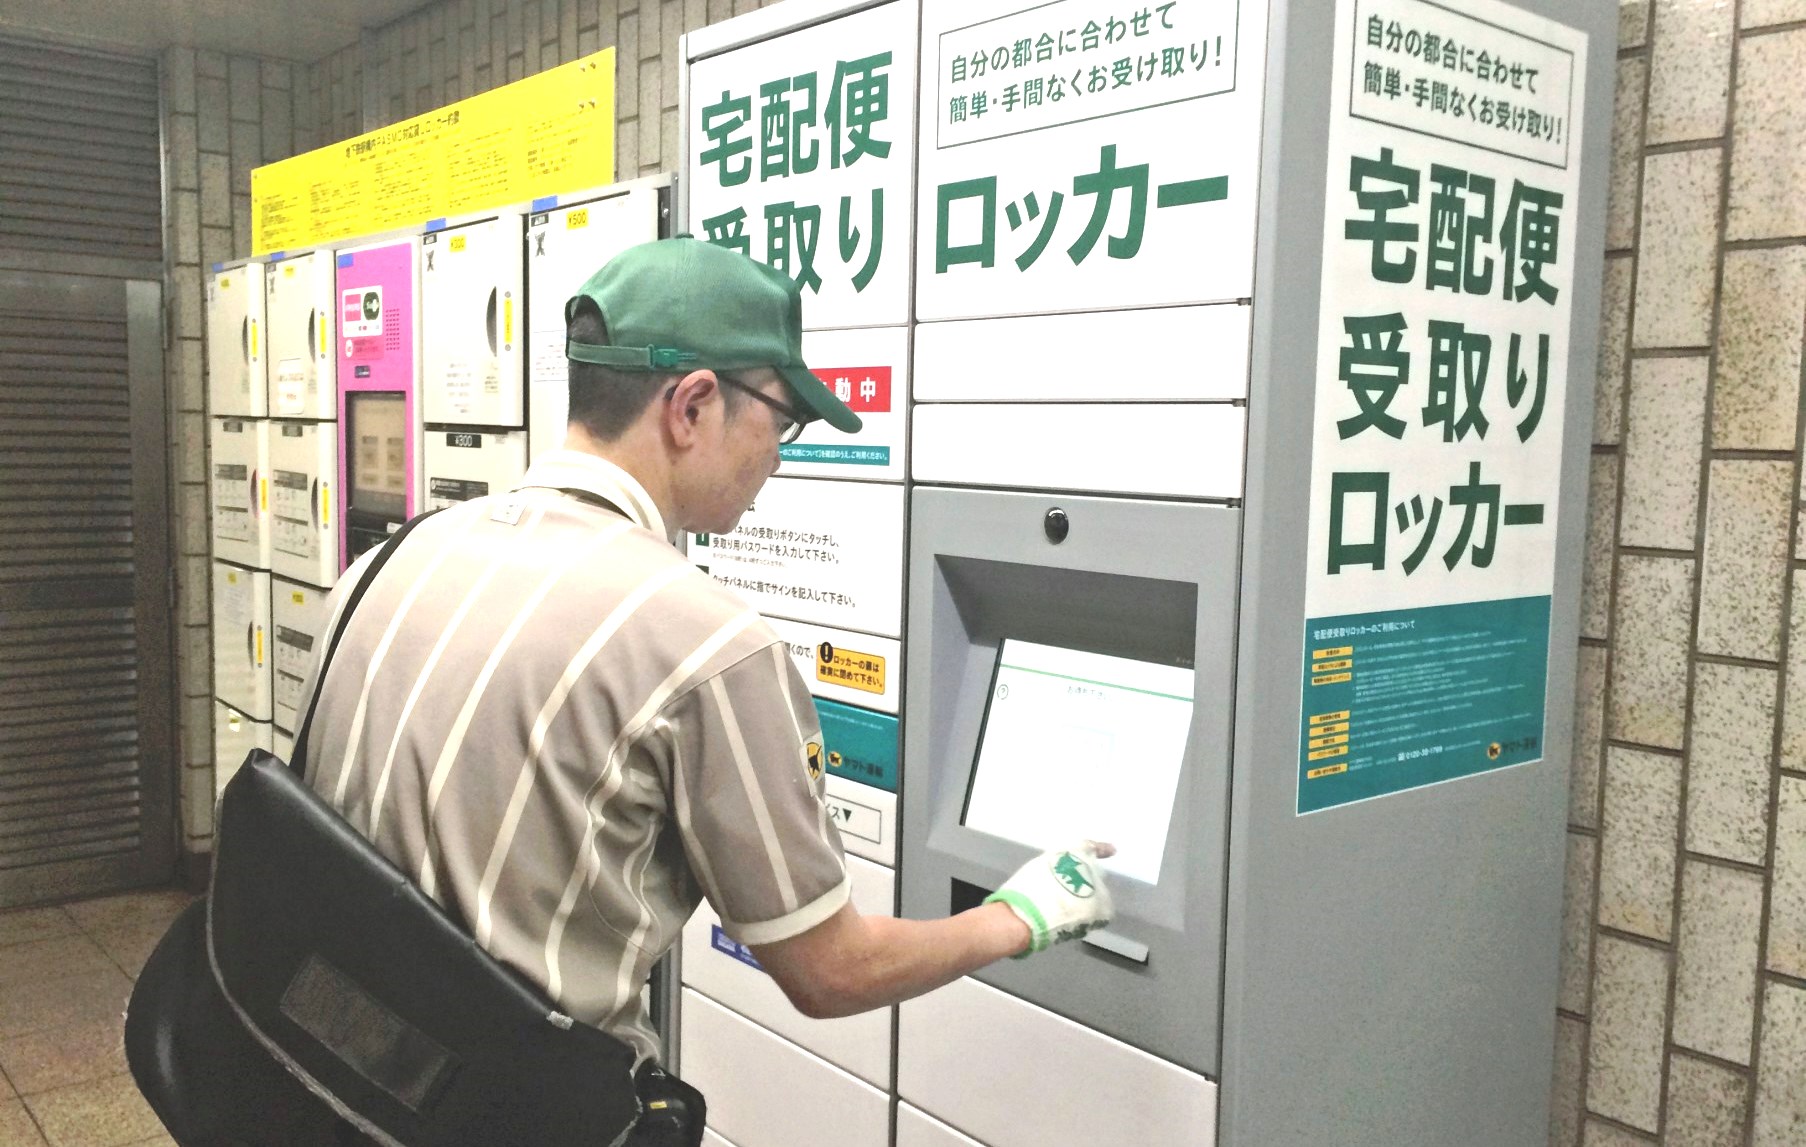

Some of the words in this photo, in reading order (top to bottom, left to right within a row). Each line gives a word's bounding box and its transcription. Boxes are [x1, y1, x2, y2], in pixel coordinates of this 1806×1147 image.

[951, 1, 1176, 83] 自分の都合に合わせて
[1367, 14, 1538, 95] 自分の都合に合わせて
[700, 50, 893, 187] 宅配便
[935, 144, 1230, 274] ロッカー
[1345, 147, 1564, 306] 宅配便
[818, 376, 876, 403] 動中
[1336, 312, 1550, 443] 受取り
[713, 537, 840, 565] 受取り用パスワードを入力して下さい。
[1327, 461, 1545, 577] ロッカー
